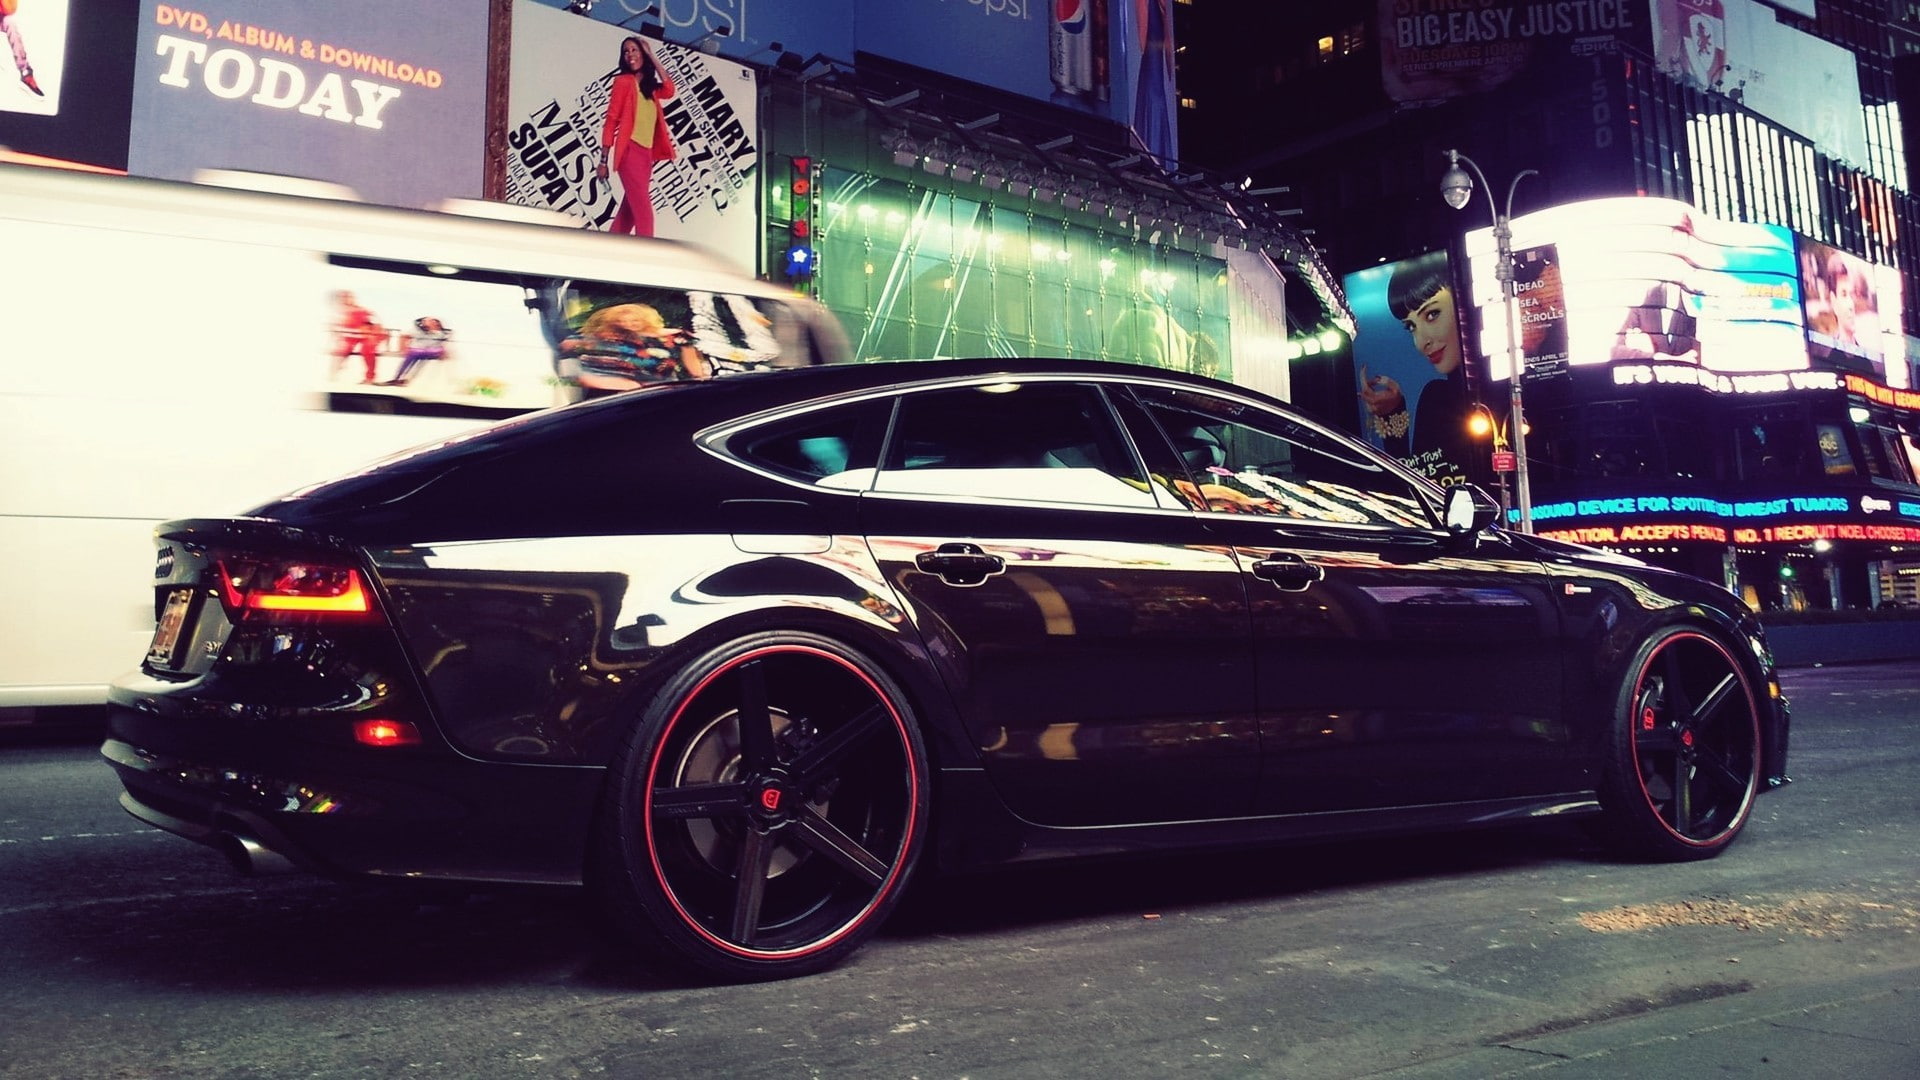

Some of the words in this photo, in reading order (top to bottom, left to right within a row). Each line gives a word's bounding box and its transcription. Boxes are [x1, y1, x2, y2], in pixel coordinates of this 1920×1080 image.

[1396, 14, 1442, 48] BIG
[1447, 8, 1514, 44] EASY
[1519, 0, 1633, 37] JUSTICE
[156, 3, 214, 40] DVD,
[216, 19, 296, 56] ALBUM
[300, 39, 316, 60] &
[319, 43, 443, 89] DOWNLOAD
[156, 33, 402, 130] TODAY
[569, 111, 602, 158] MADE
[691, 75, 756, 161] MARY
[528, 98, 618, 231] MISSY
[699, 120, 720, 147] SHE
[713, 145, 744, 190] STYLED
[1518, 280, 1545, 292] DEAD
[1520, 299, 1540, 308] SEA
[1521, 310, 1565, 324] SCROLLS
[1421, 448, 1443, 463] Trust
[1449, 463, 1459, 473] in
[1578, 498, 1636, 516] DEVICE
[1637, 496, 1671, 512] FOR
[1734, 500, 1789, 517] BREAST
[1790, 498, 1849, 512] TUMORS
[1620, 525, 1690, 541] ACCEPTS
[1733, 528, 1762, 542] NO.
[1762, 528, 1773, 541] 1
[1773, 525, 1837, 540] RECRUIT
[1837, 525, 1867, 539] NOEL
[1866, 526, 1906, 540] CHOOSES
